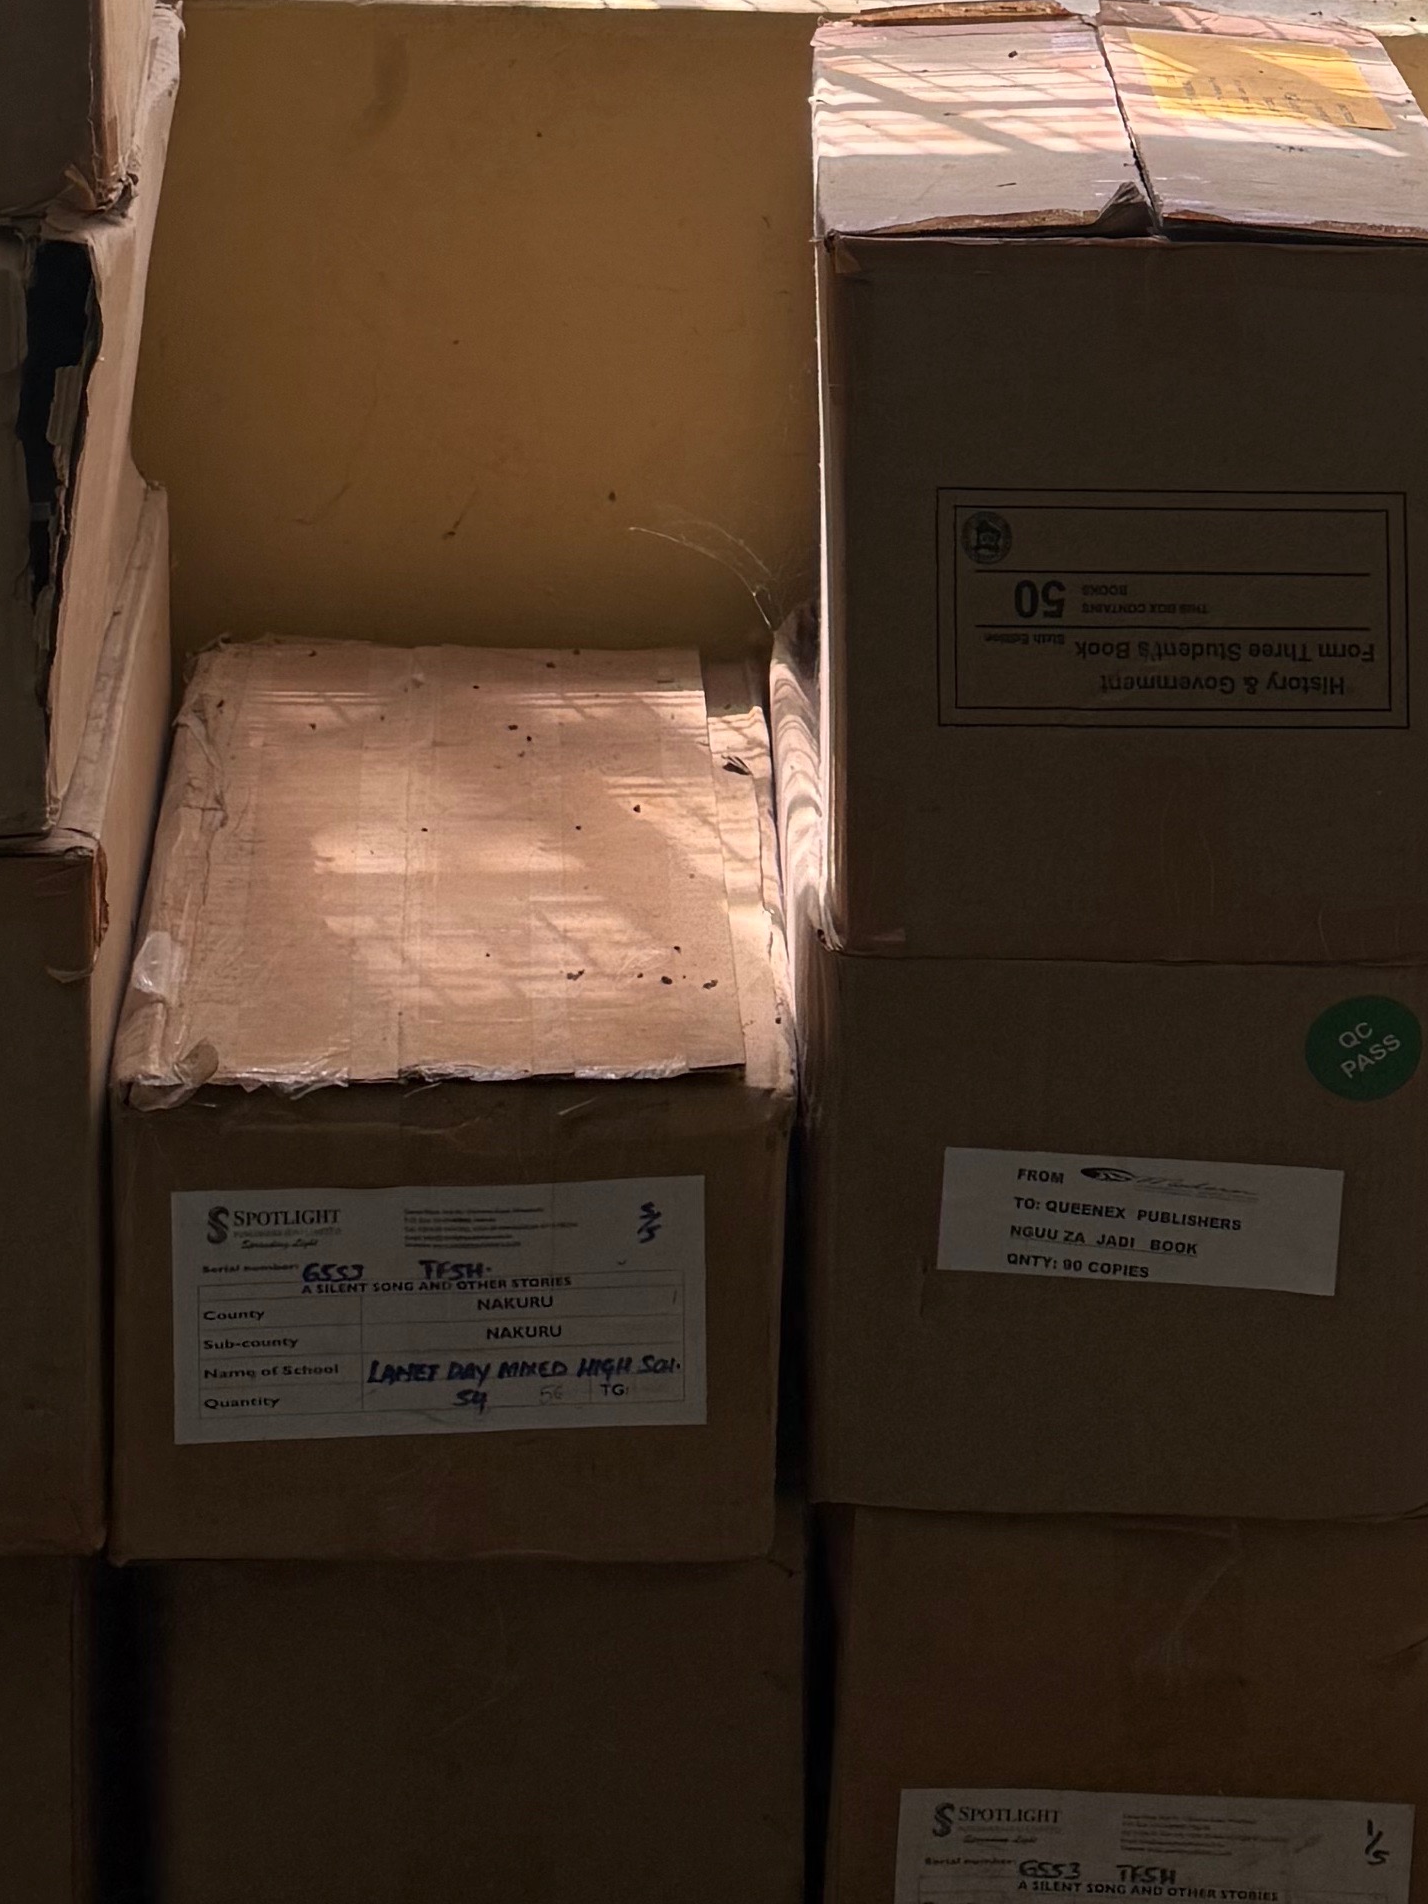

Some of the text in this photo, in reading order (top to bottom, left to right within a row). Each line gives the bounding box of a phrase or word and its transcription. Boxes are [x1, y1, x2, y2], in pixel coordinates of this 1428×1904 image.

[1013, 580, 1068, 620] 50
[1074, 639, 1375, 663] Form Three Student's Book
[1099, 672, 1346, 696] History & Government
[1337, 1021, 1375, 1051] QC
[1339, 1032, 1402, 1079] PASS
[1017, 1167, 1065, 1184] FROM
[233, 1208, 341, 1227] SPOTLIGHT
[1014, 1197, 1242, 1231] TO: QUEENEX PUBLISHERS
[1010, 1225, 1198, 1256] NGUU ZA JADI BOOK
[1006, 1253, 1058, 1271] QNTY:
[1088, 1260, 1150, 1279] COPIES
[302, 1276, 572, 1295] A SILENT SONG AND OTHER STORIES
[203, 1295, 554, 1322] County NAKURU
[203, 1325, 563, 1351] Sub-county NAKURU
[203, 1363, 339, 1379] Name of School
[367, 1359, 441, 1384] LANET
[446, 1360, 491, 1386] DAY
[497, 1359, 568, 1379] MIXED
[576, 1355, 632, 1378] HIGH
[203, 1395, 281, 1410] Quantity
[957, 1805, 1061, 1825] SPOTLIGHT
[1017, 1879, 1029, 1891] A
[1032, 1880, 1082, 1893] SILENT
[1086, 1883, 1127, 1895] SONG
[1130, 1885, 1164, 1897] AND
[1167, 1886, 1216, 1899] OTHER
